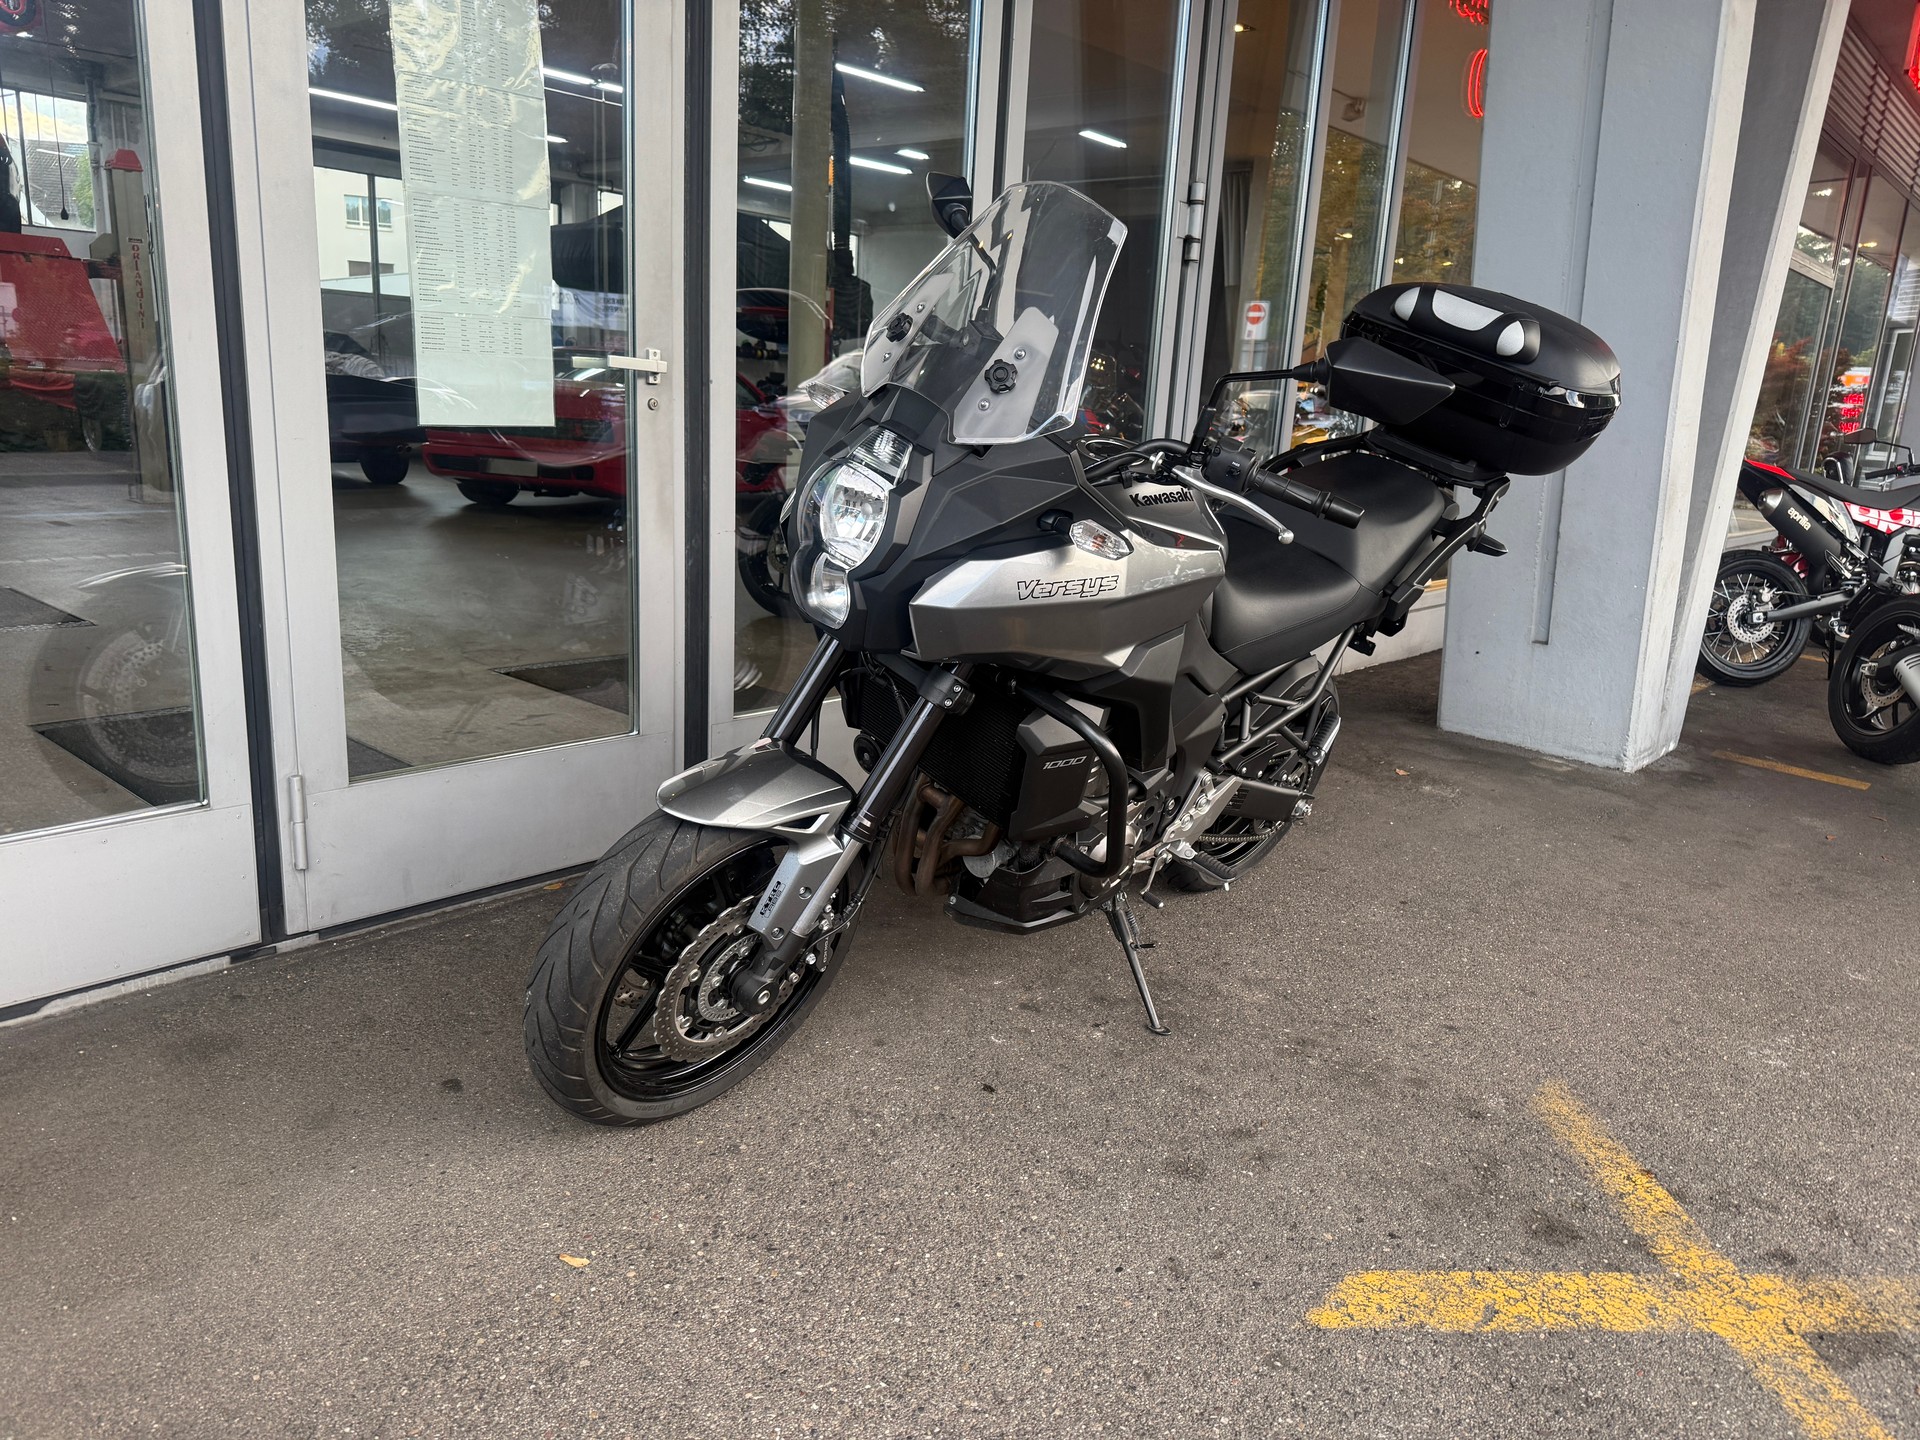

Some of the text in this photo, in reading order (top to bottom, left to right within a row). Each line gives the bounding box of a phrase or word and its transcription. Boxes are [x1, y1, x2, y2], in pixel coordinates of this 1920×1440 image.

[1129, 487, 1194, 507] Kawasaki
[1787, 506, 1812, 531] aprilia
[1017, 575, 1119, 600] Versys
[1043, 755, 1087, 770] 1000
